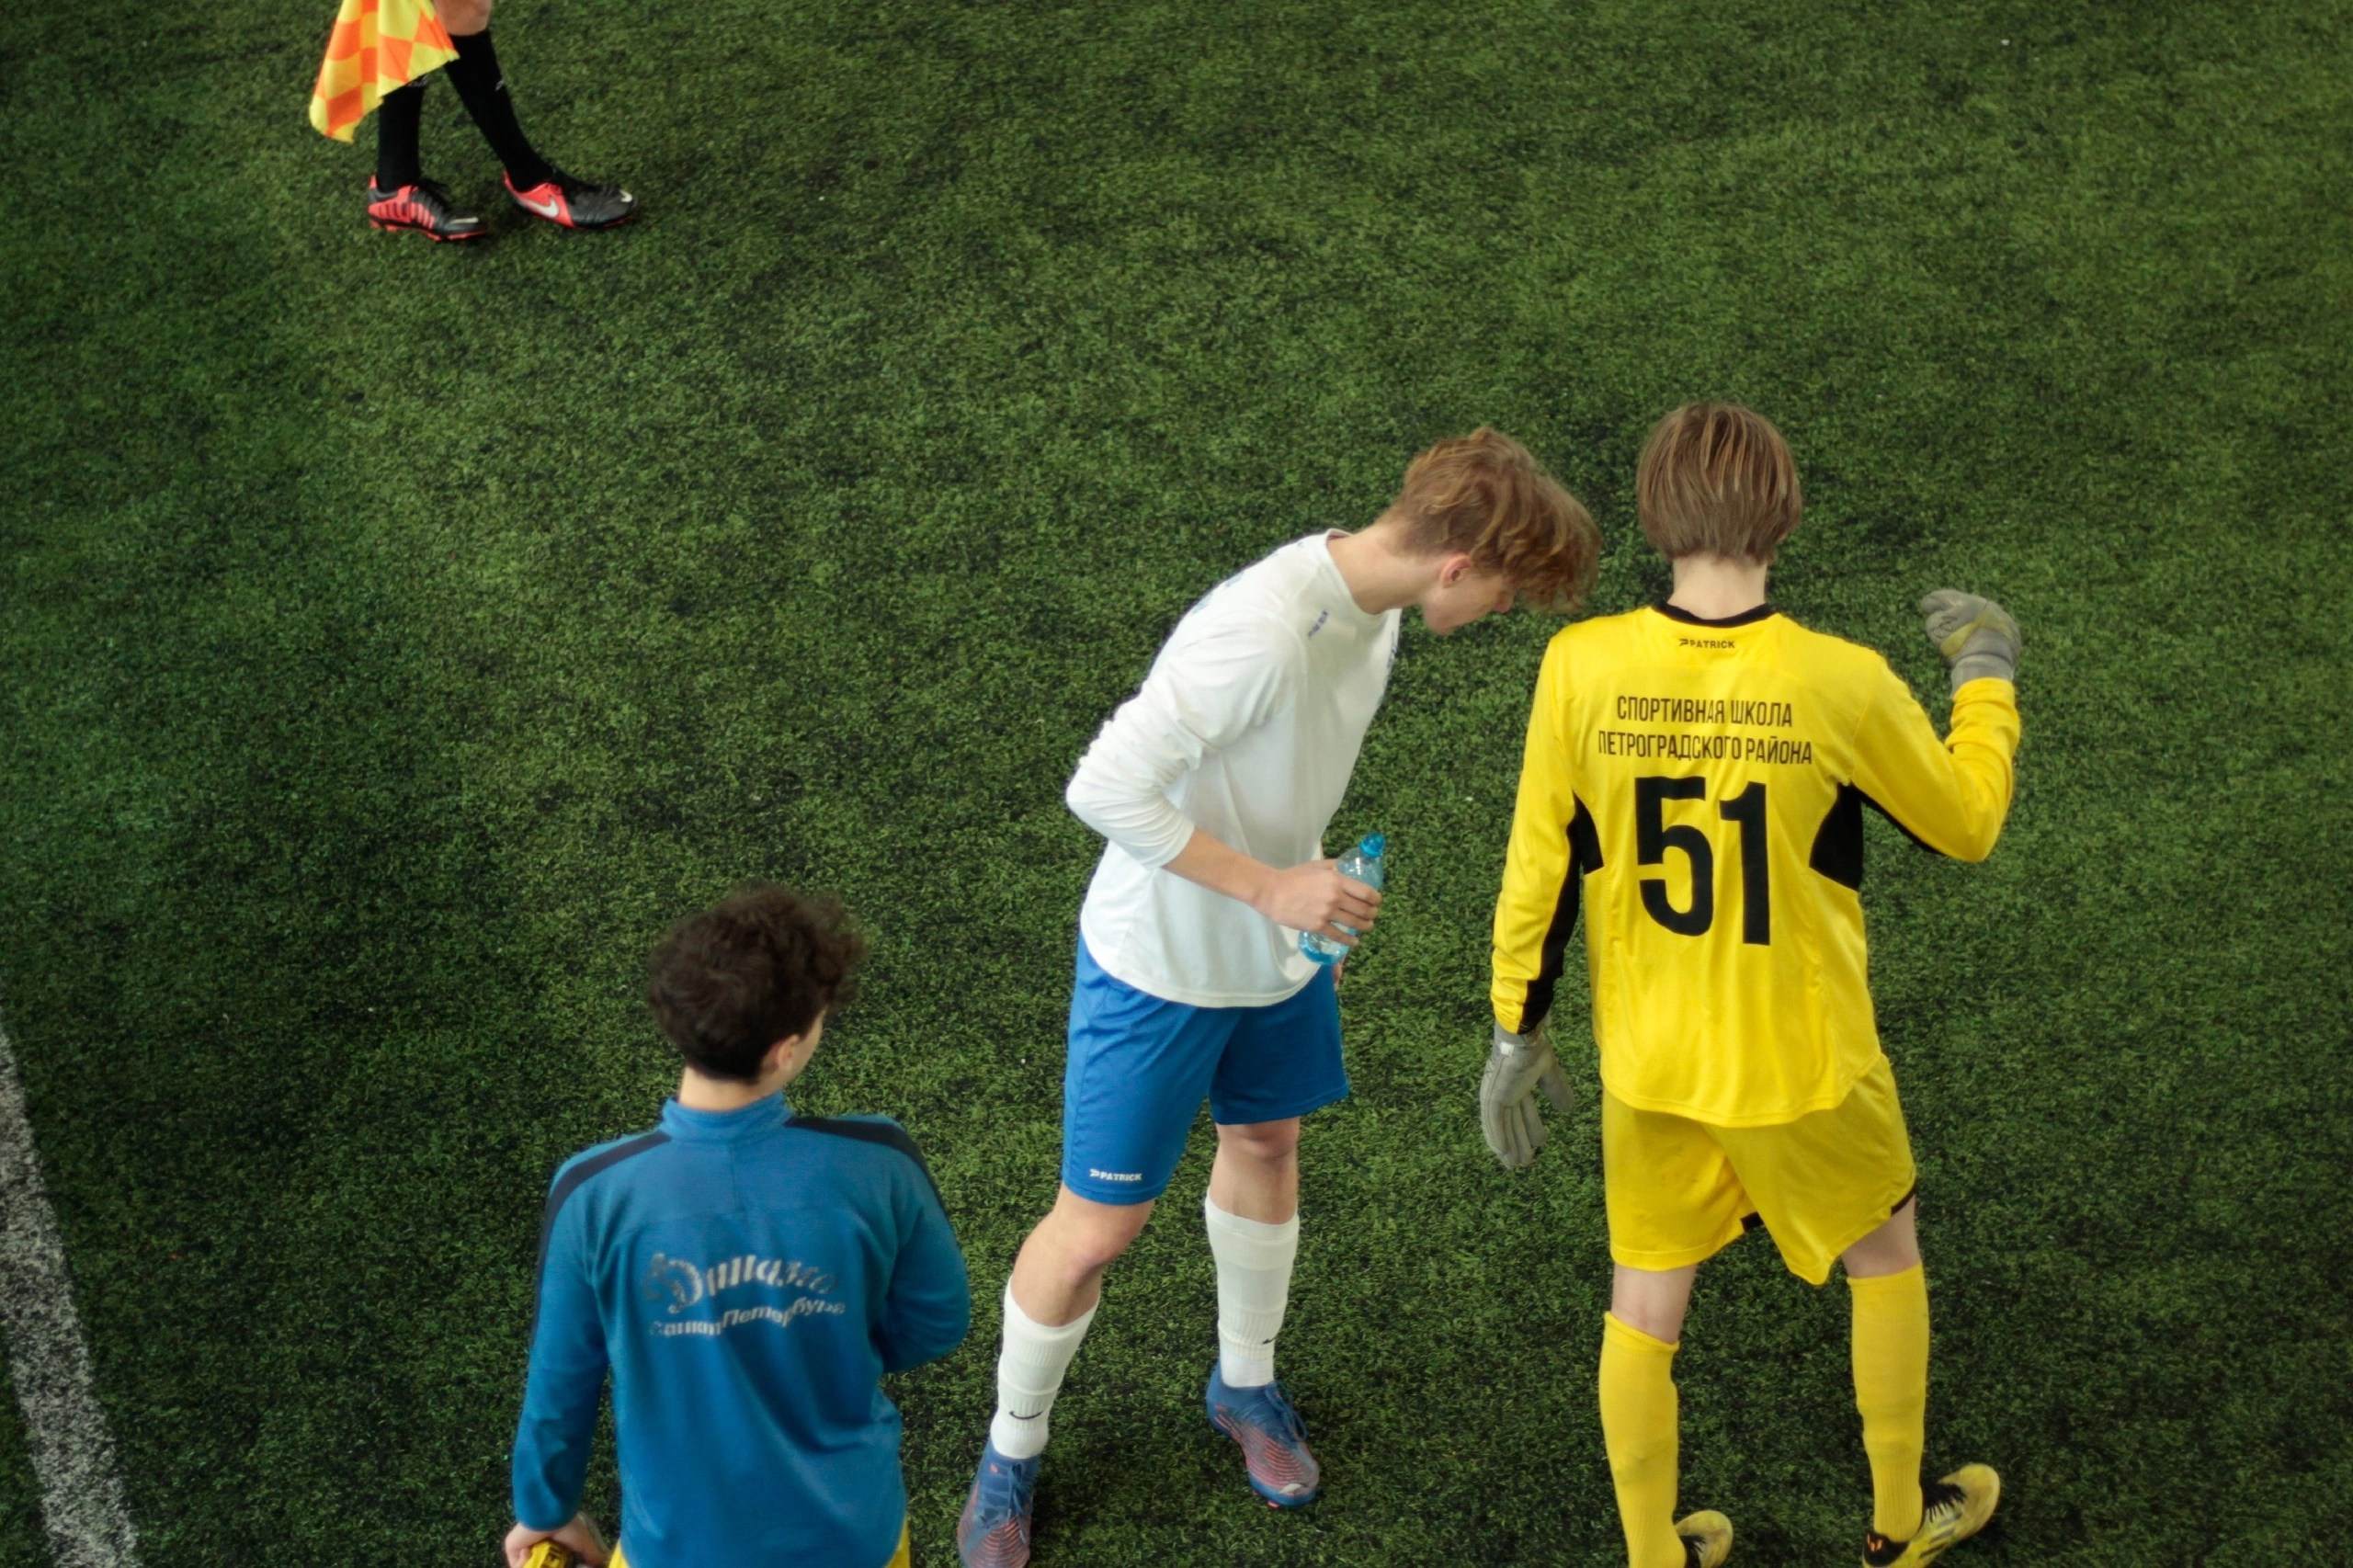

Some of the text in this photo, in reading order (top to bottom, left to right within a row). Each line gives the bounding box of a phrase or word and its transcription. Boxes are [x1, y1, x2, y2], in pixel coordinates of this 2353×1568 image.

[1689, 639, 1735, 649] PATRICK
[1617, 695, 1792, 728] СПОРТИВНАЯ ШКОЛА
[1598, 730, 1813, 765] ПЕТРОГРАДСКОГО РАЙОНА
[1634, 775, 1770, 946] 51
[1099, 1171, 1142, 1182] PATRICK
